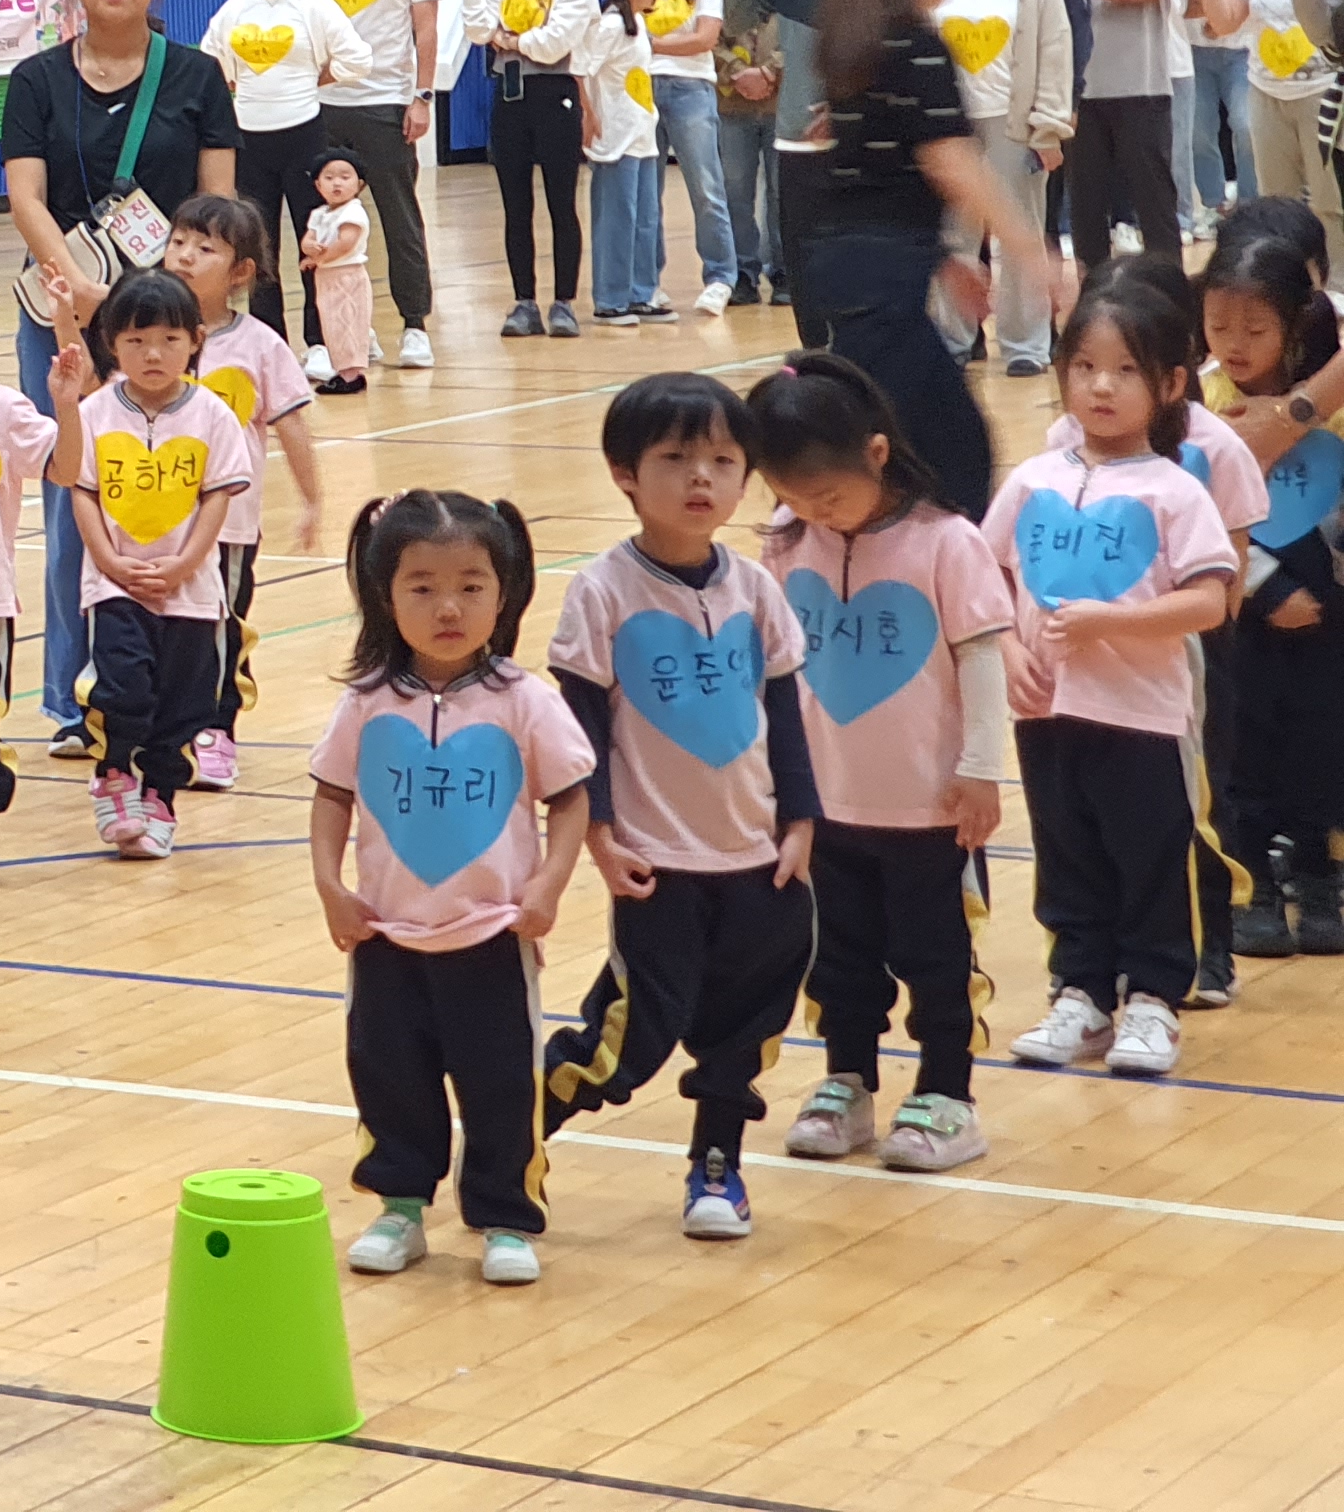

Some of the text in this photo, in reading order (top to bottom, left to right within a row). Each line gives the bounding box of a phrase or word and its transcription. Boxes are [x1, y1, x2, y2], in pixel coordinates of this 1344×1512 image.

[103, 453, 198, 500] 공하선
[799, 609, 904, 656] 김시호
[387, 766, 496, 814] 김규리
